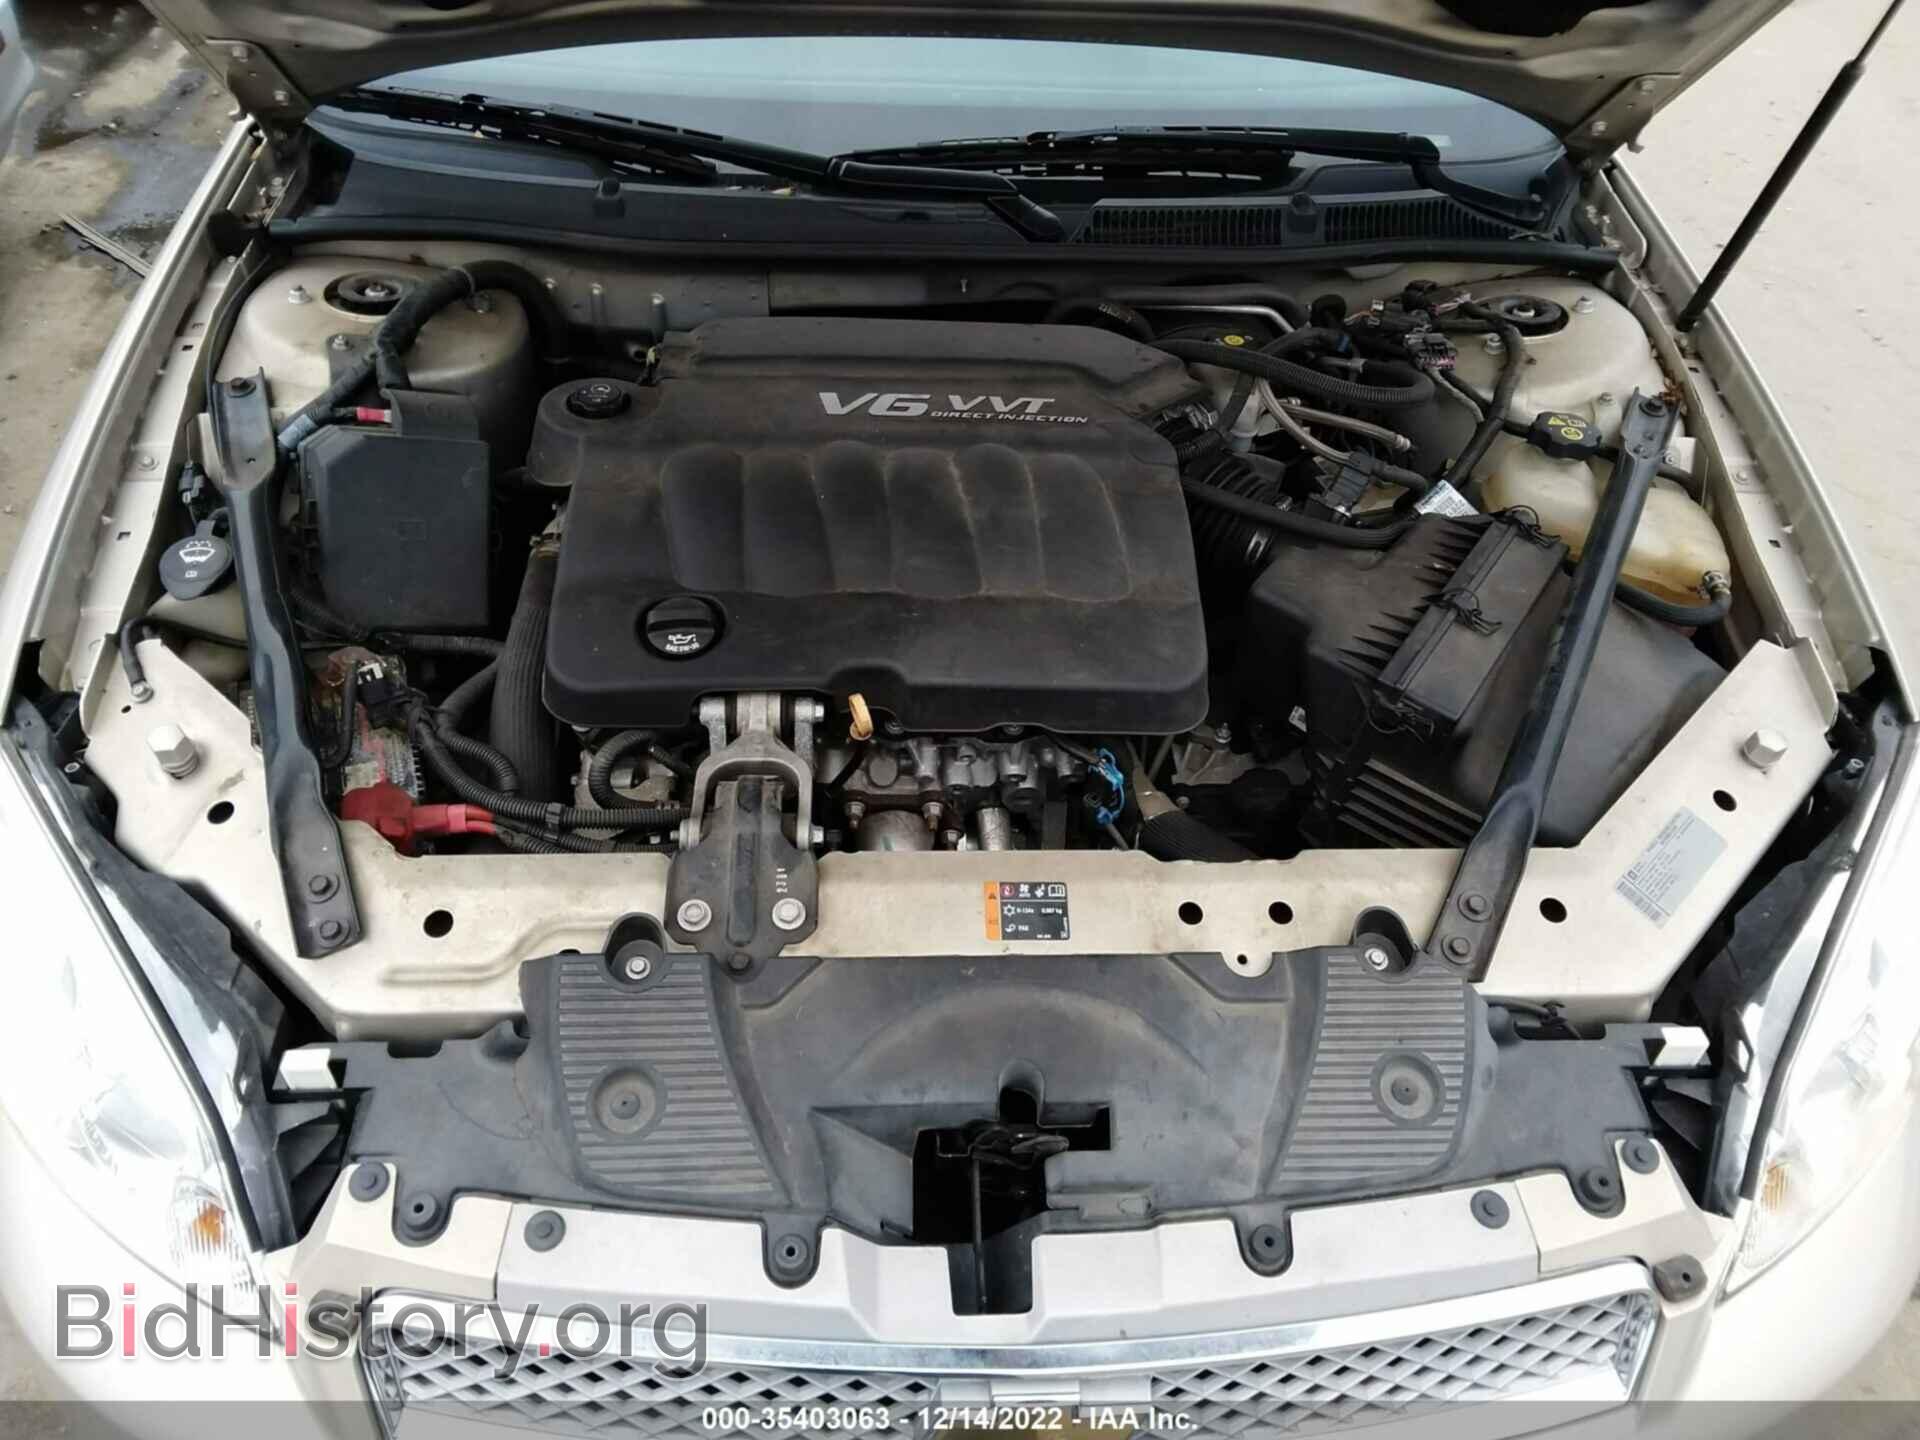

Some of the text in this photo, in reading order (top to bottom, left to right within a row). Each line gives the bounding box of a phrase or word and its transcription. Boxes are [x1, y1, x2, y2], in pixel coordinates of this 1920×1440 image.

[819, 392, 1055, 416] V6 VVT
[931, 411, 1088, 423] DIRECT INJECTION
